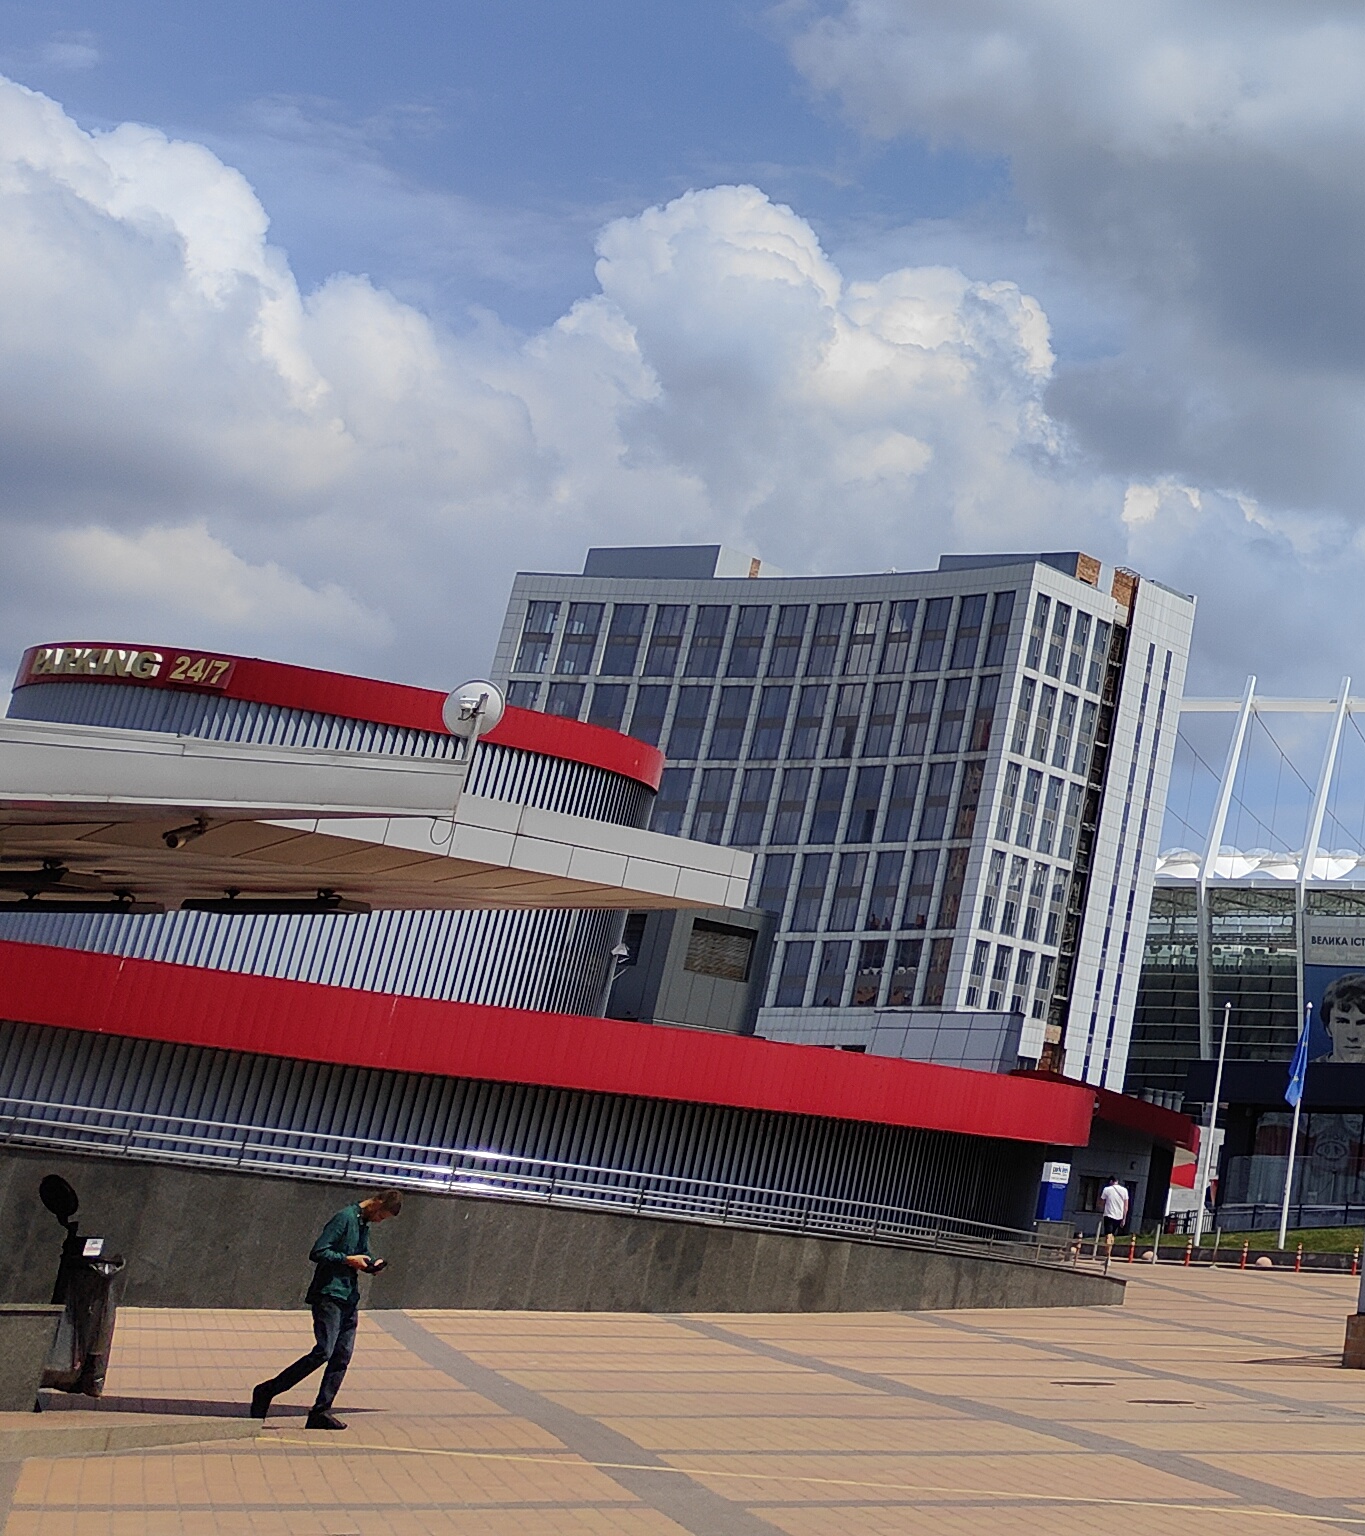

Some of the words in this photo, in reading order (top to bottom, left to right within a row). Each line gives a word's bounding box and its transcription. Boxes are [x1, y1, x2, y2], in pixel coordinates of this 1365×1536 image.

[30, 647, 163, 680] PARKING
[169, 655, 231, 685] 24/7
[1311, 935, 1348, 946] ВЕЛИКА
